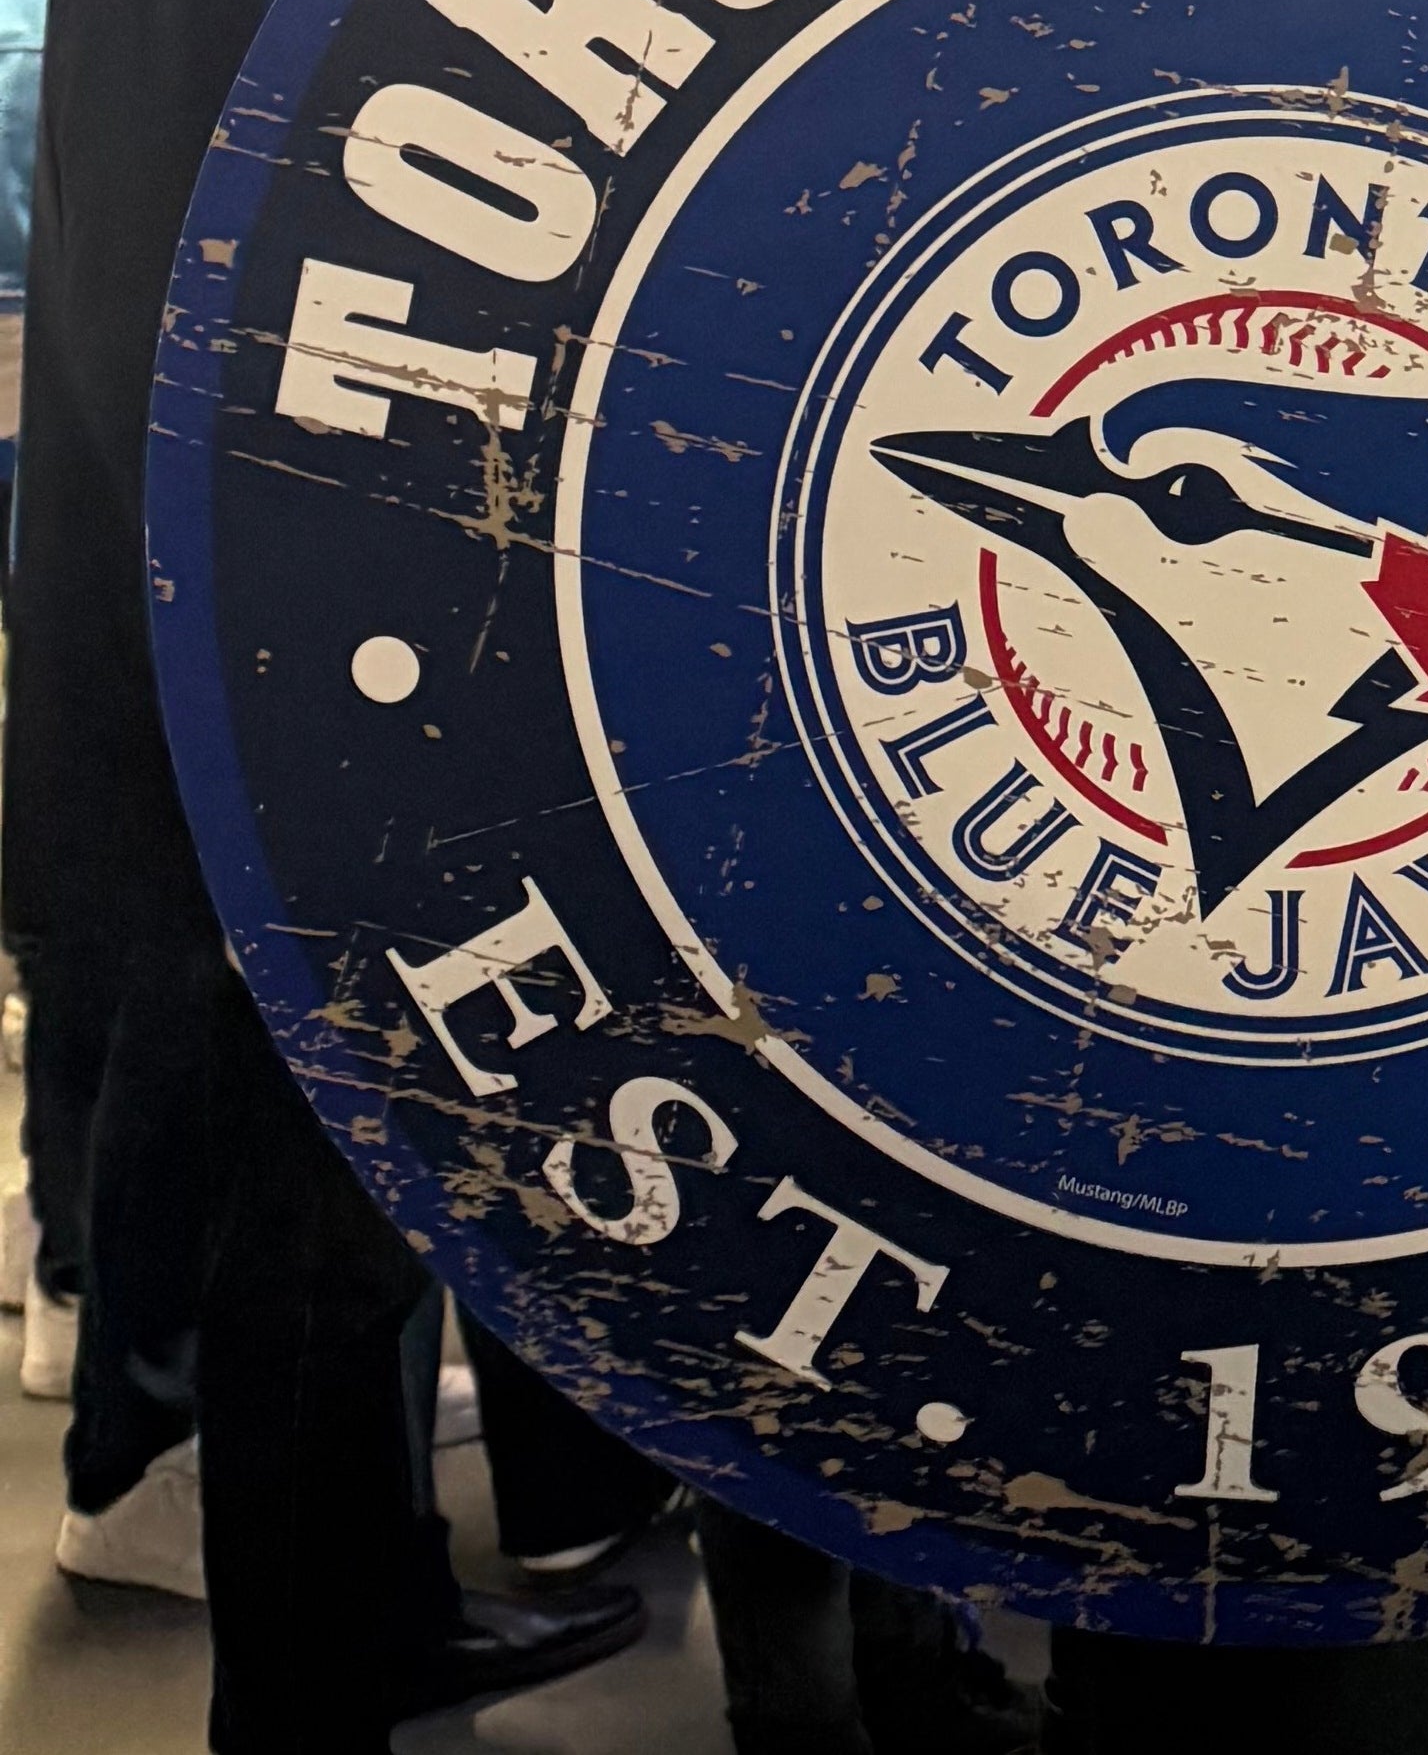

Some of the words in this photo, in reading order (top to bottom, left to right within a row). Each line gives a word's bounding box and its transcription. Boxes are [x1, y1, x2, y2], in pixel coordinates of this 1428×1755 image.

[844, 601, 1169, 964] BLUE
[387, 877, 969, 1443] EST.
[1058, 1174, 1188, 1217] Mustang/MLBP
